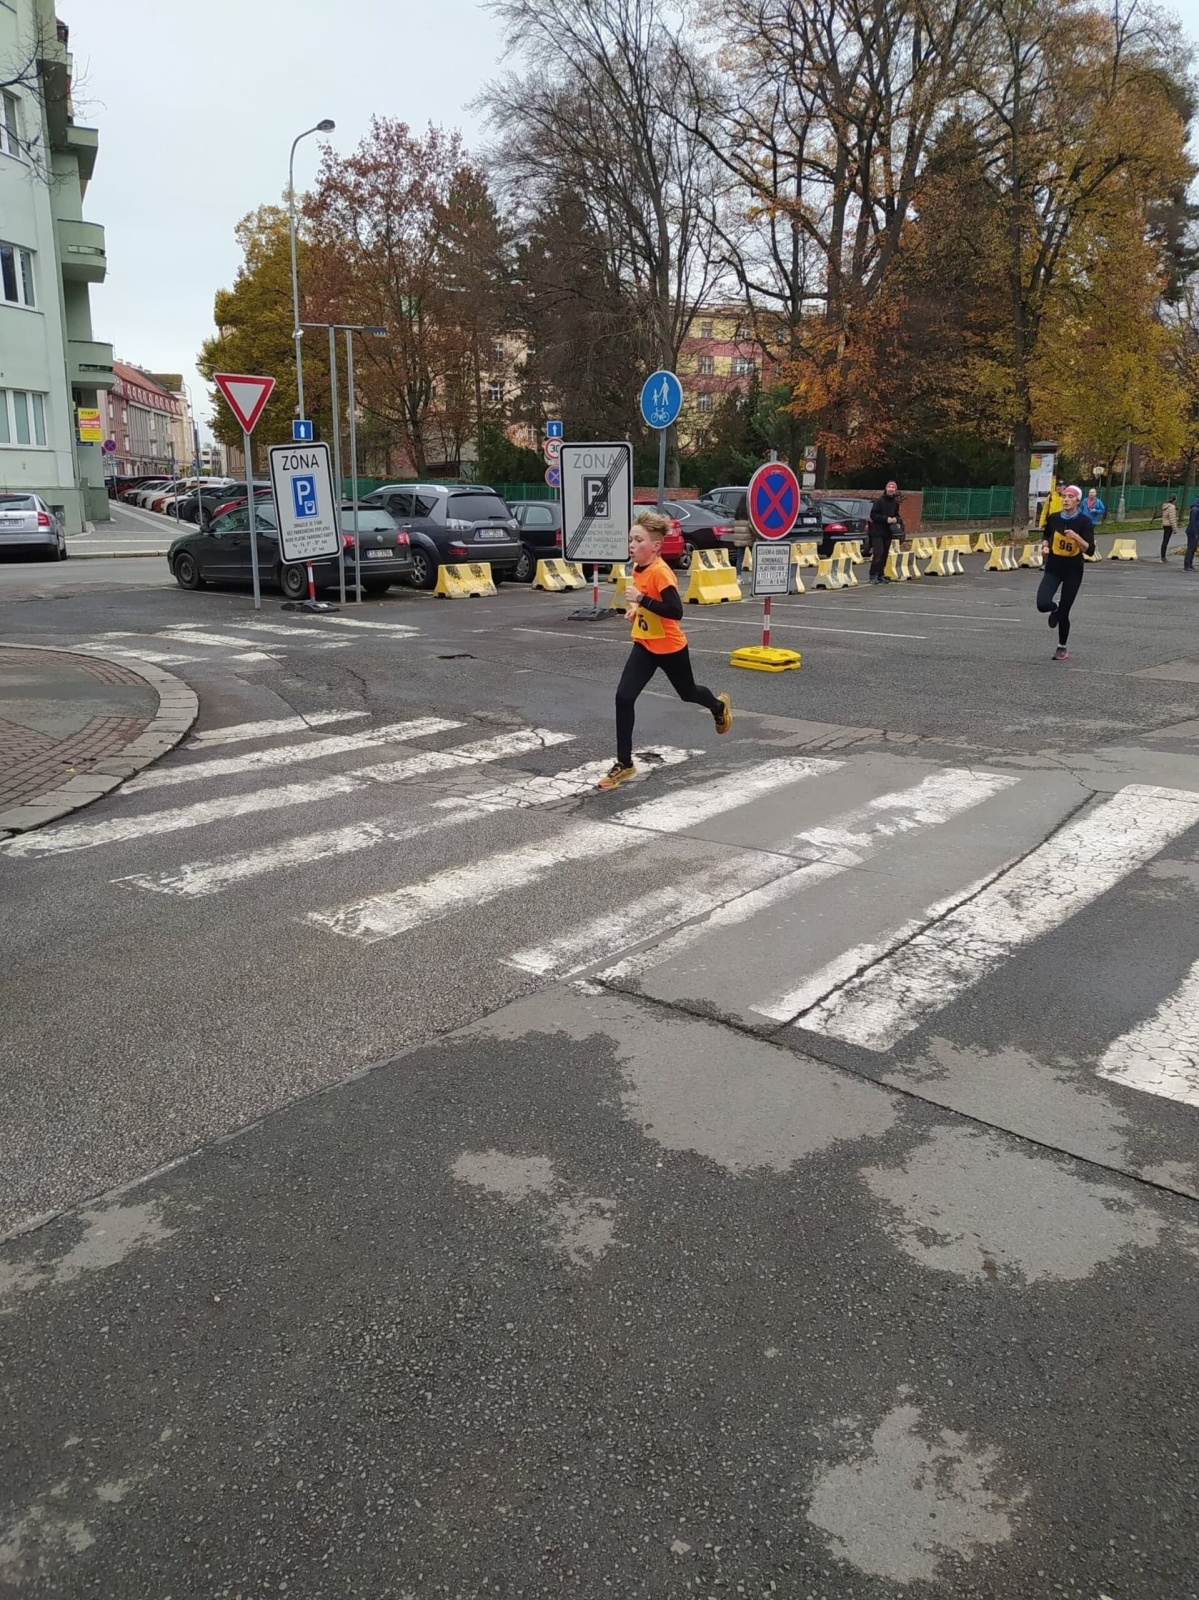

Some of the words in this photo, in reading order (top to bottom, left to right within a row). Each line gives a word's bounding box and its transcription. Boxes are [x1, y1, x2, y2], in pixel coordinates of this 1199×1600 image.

[281, 451, 320, 471] ZÓNA
[573, 449, 617, 469] ZÓNA
[296, 480, 311, 506] P
[1059, 539, 1073, 552] 96
